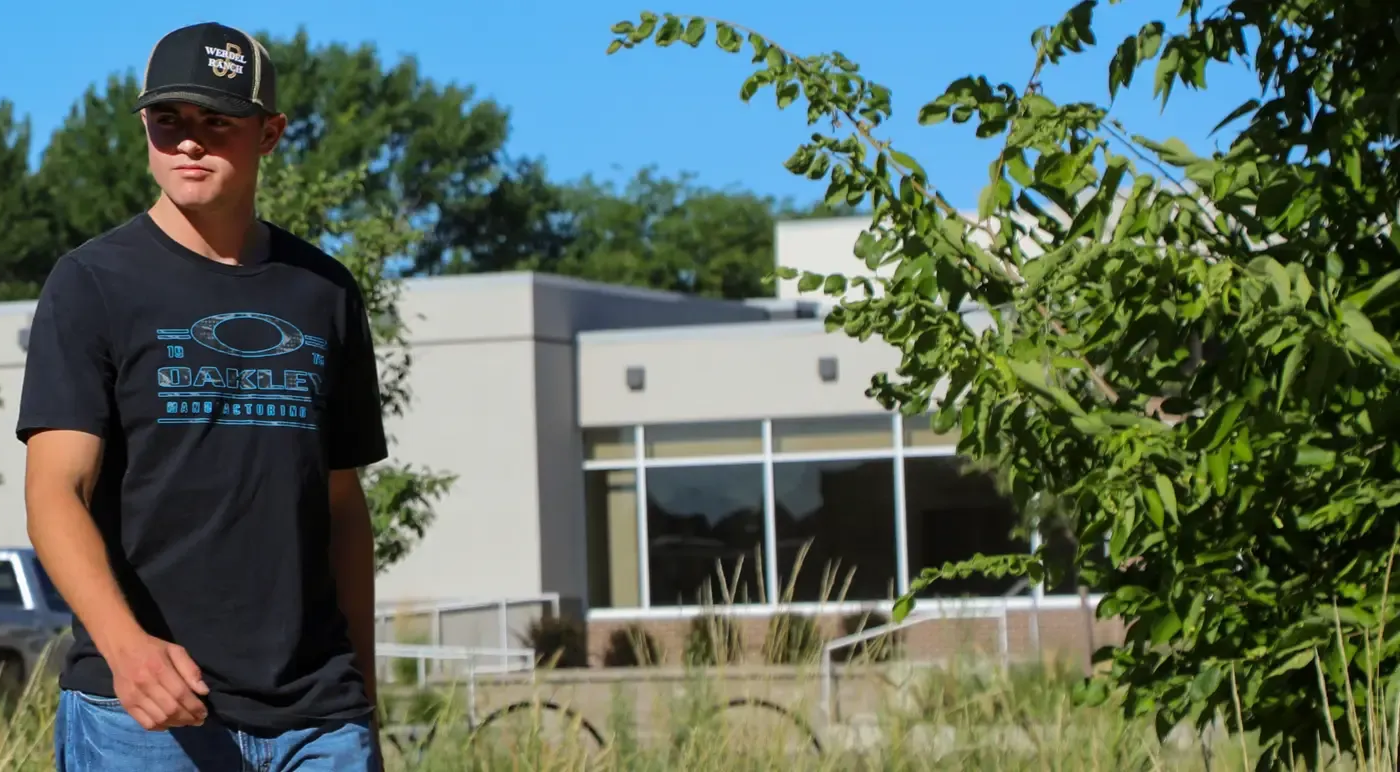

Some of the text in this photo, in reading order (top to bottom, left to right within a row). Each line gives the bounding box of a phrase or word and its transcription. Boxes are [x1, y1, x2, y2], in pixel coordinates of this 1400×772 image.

[205, 46, 247, 64] WERDEL
[208, 58, 243, 74] RANCH
[167, 345, 184, 358] 19
[158, 366, 323, 395] OAKLEY
[166, 401, 307, 418] MANUACTURING
